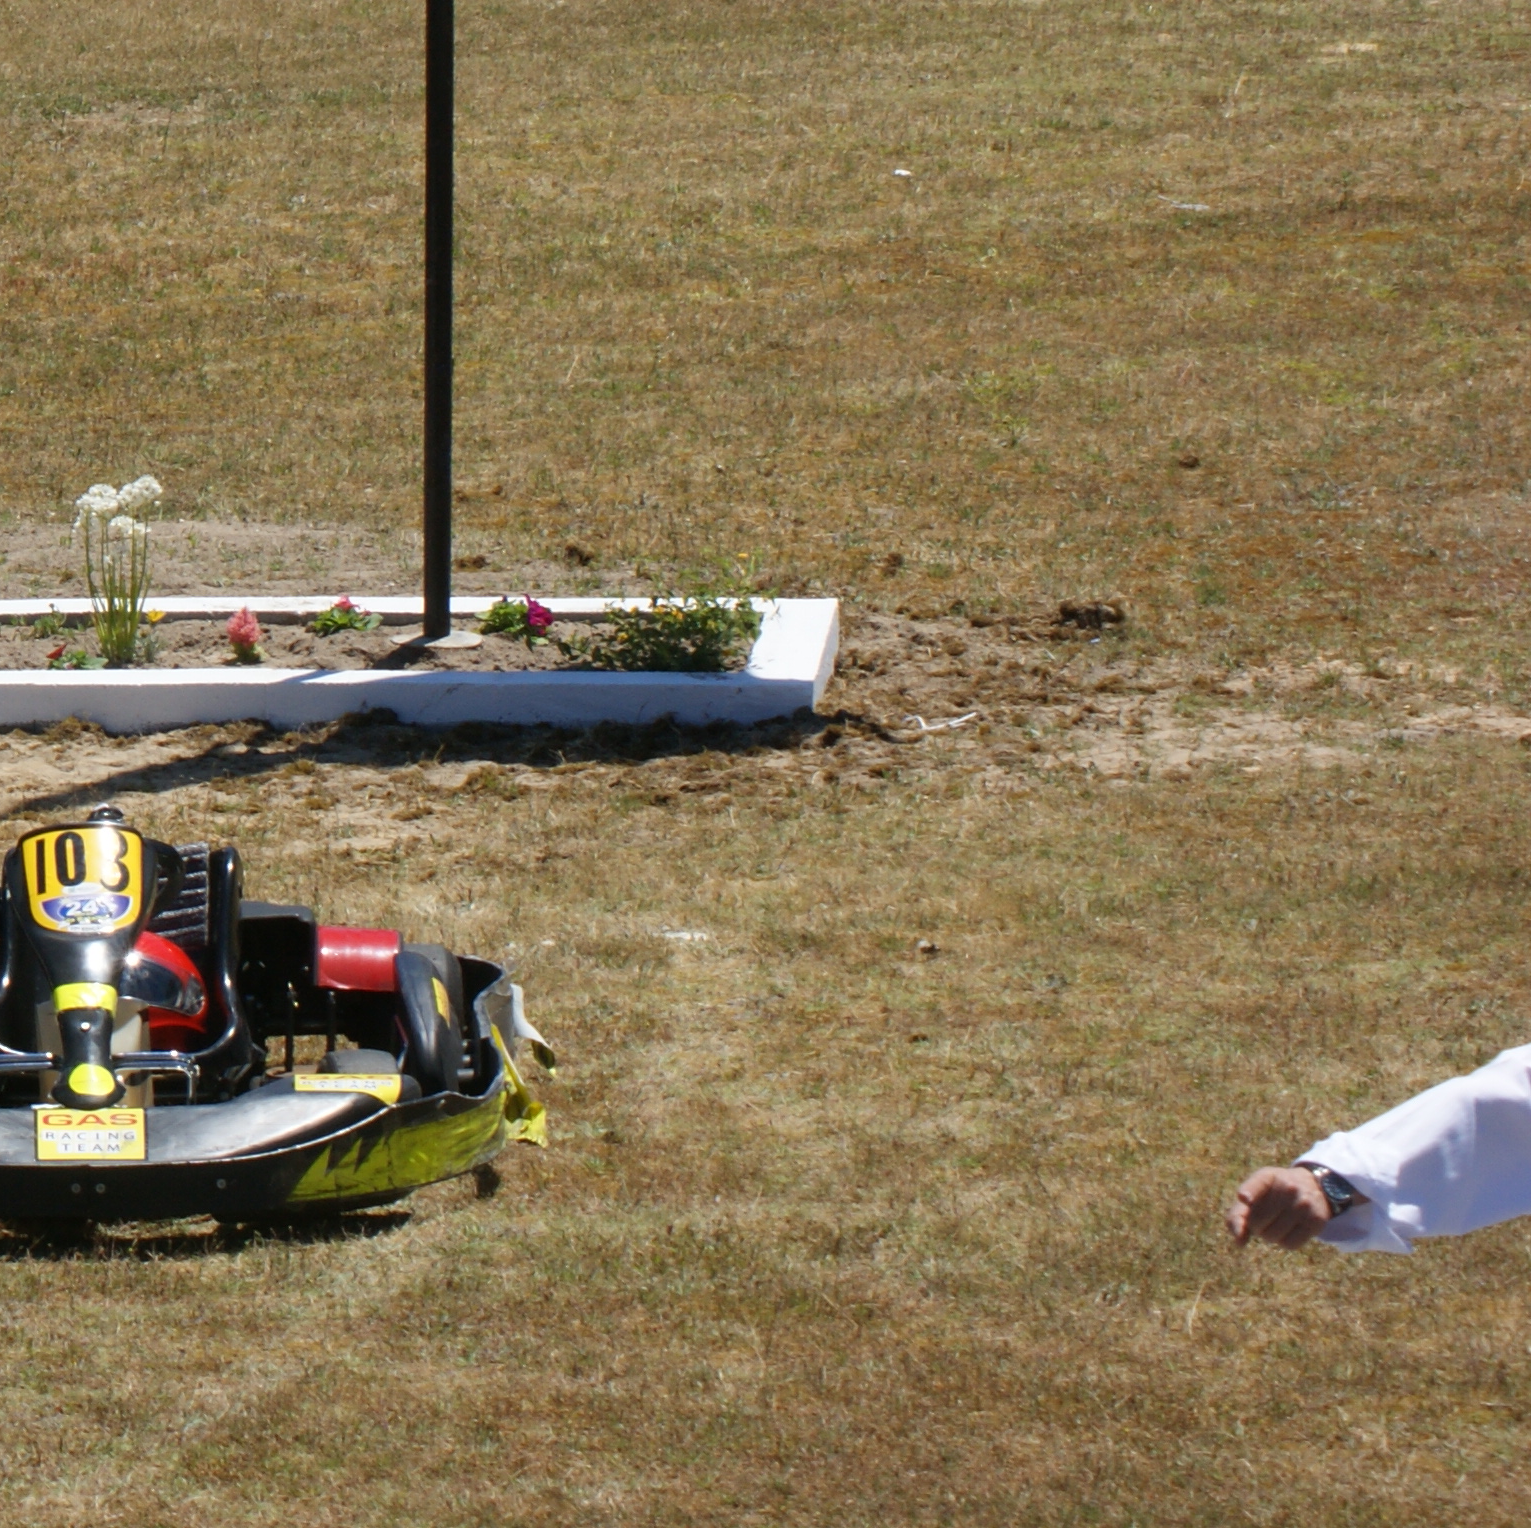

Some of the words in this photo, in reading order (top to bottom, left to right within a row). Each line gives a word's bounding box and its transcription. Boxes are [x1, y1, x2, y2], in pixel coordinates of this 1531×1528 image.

[35, 827, 130, 895] 103
[42, 1113, 138, 1126] GAS
[45, 1131, 136, 1140] RACING
[61, 1143, 121, 1152] TEAM
